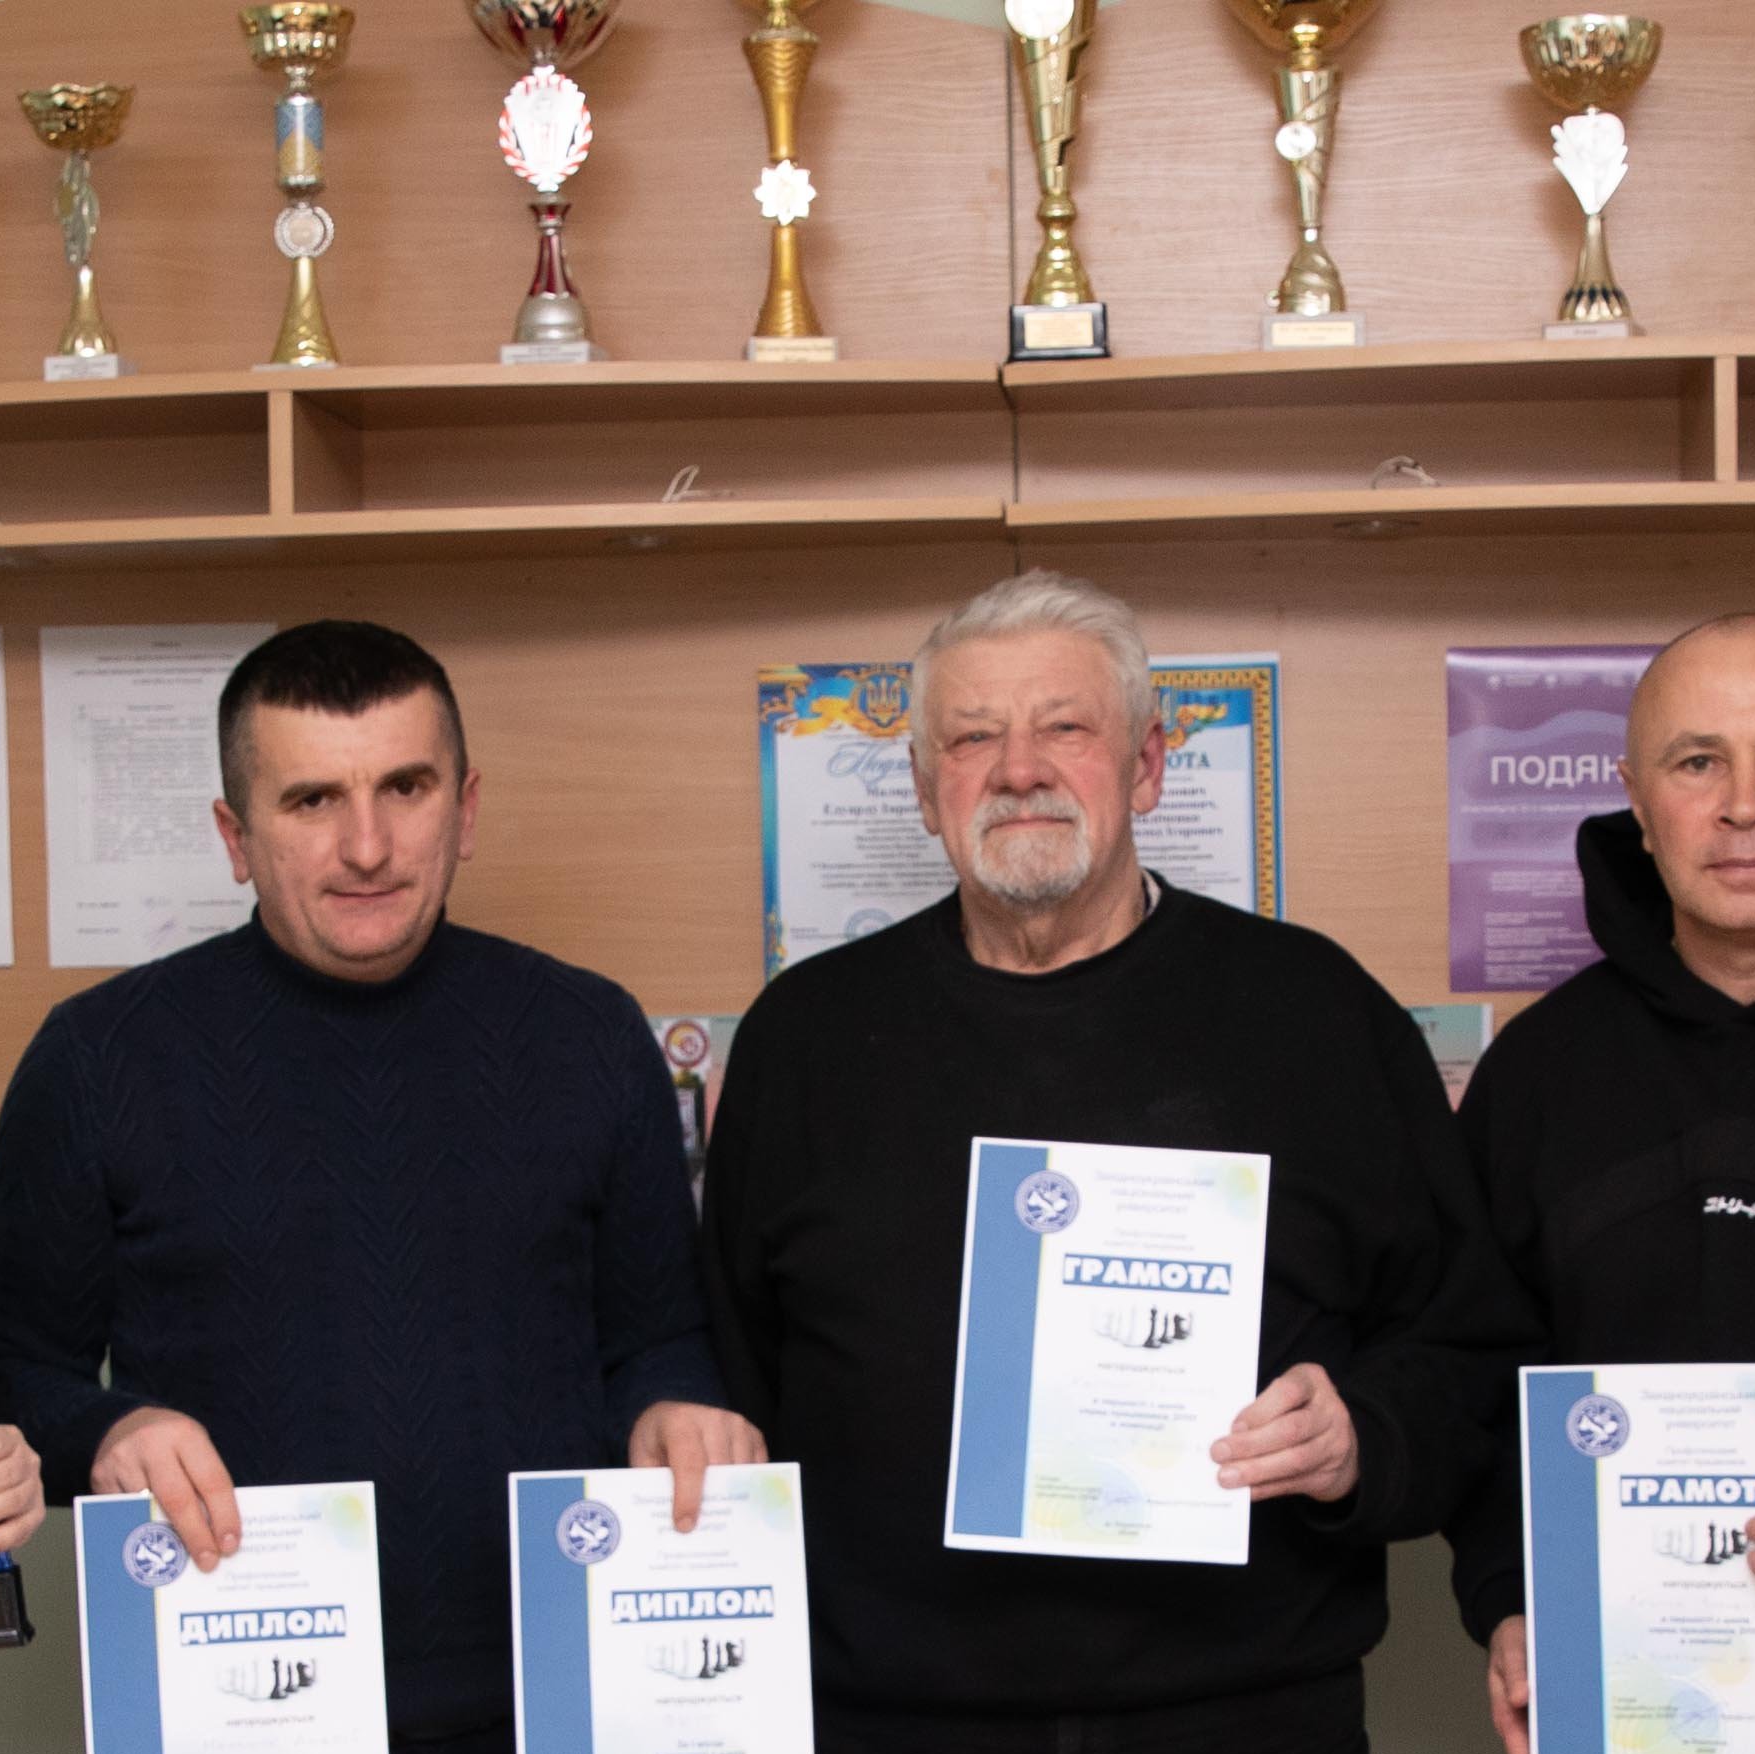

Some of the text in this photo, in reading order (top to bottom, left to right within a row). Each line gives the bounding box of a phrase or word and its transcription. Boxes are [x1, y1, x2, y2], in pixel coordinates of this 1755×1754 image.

[1491, 755, 1624, 788] ПОДЯК
[1064, 1258, 1231, 1290] ГРАМОТА
[612, 1588, 774, 1622] ДИПЛОМ
[181, 1608, 346, 1645] ДИПЛОМ
